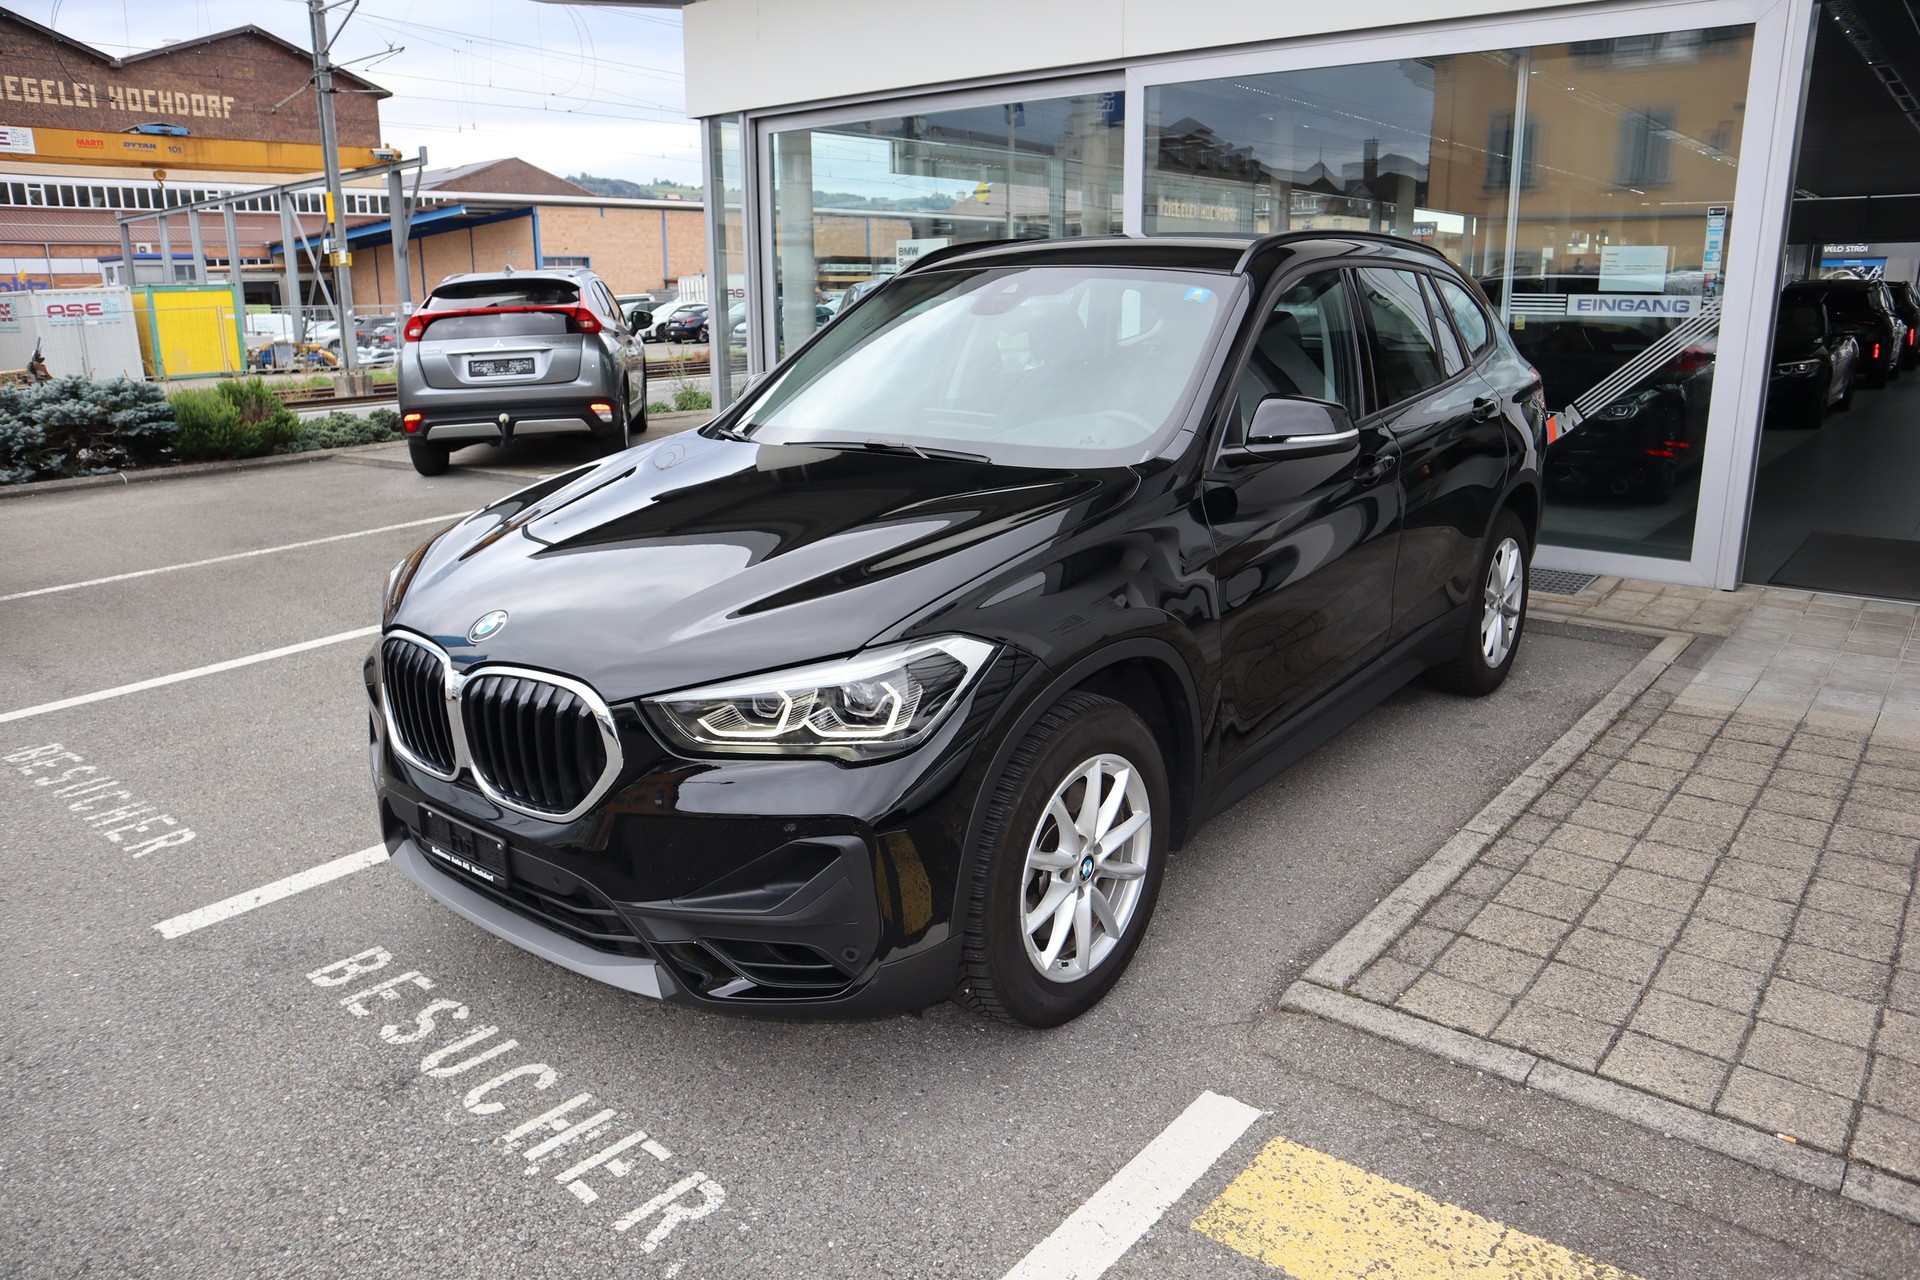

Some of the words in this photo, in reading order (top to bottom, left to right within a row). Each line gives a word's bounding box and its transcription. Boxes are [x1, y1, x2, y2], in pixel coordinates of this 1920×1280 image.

[107, 85, 235, 119] HOCHDORF
[76, 138, 104, 147] MARTI
[898, 246, 919, 256] BMW
[1823, 245, 1844, 253] VELO
[46, 302, 104, 319] ASE
[1577, 298, 1690, 314] EINGANG
[2, 742, 197, 859] BESUCHER
[305, 945, 727, 1254] BESUCHER
